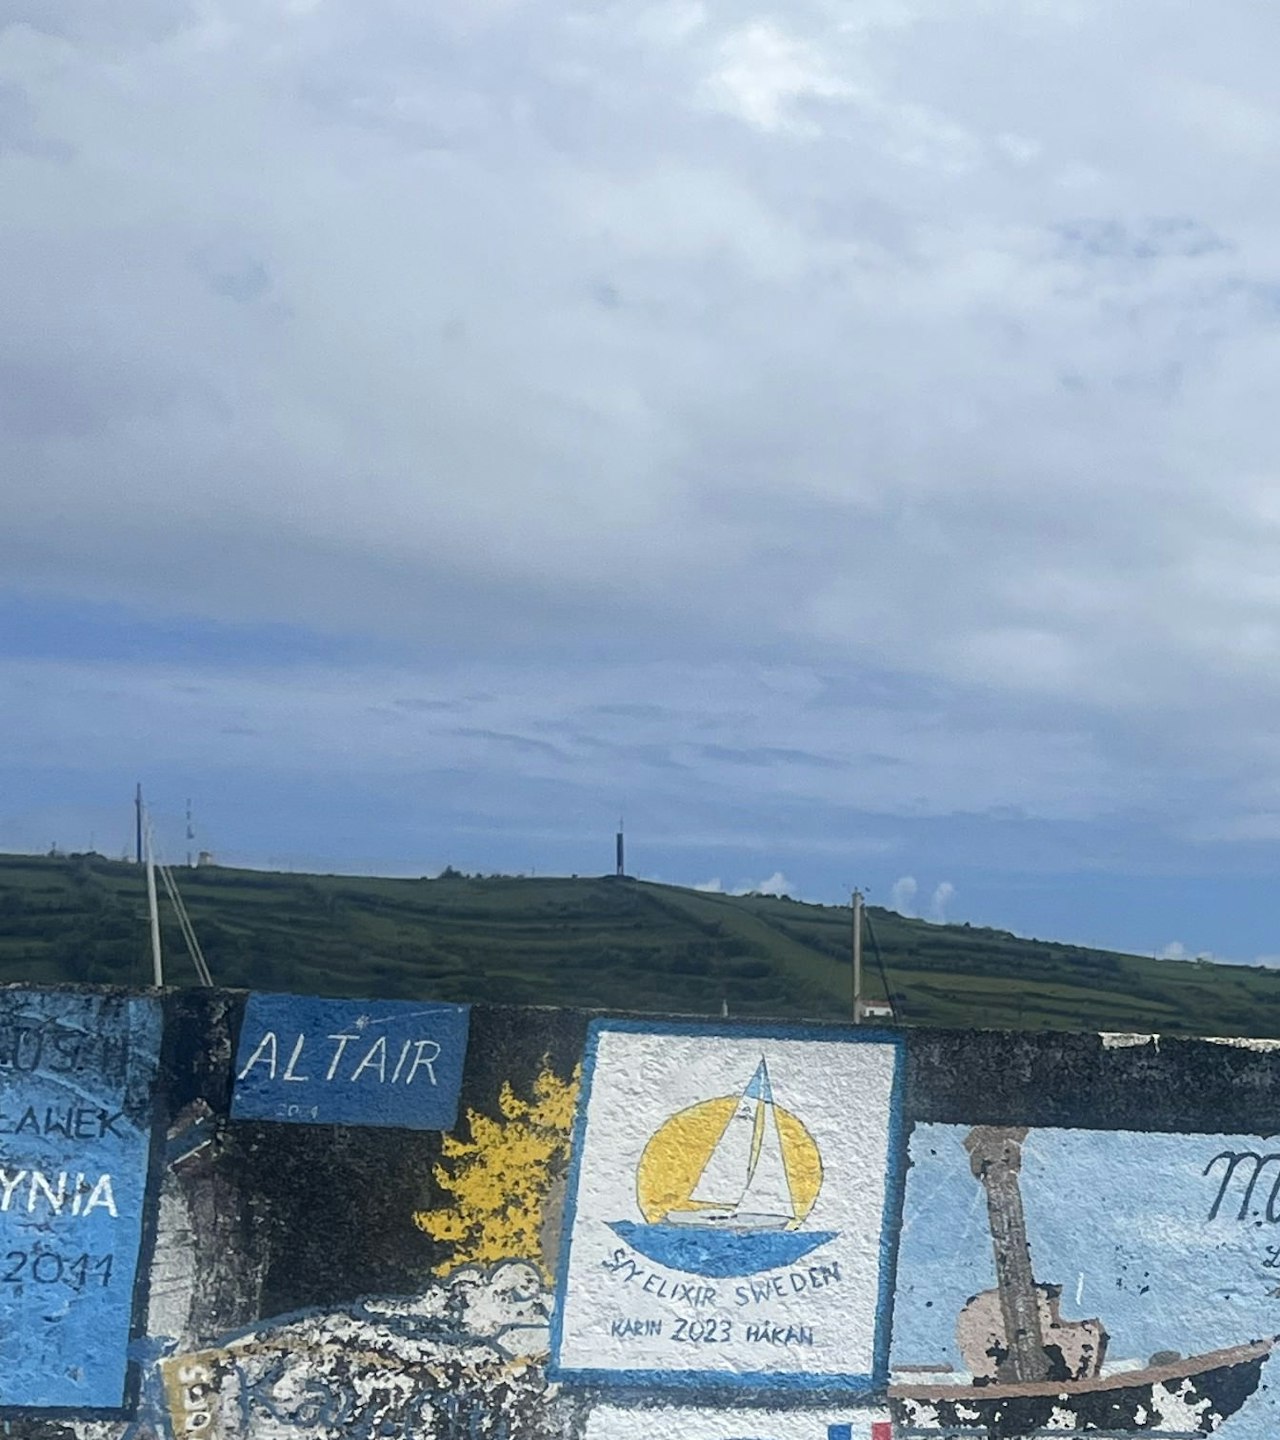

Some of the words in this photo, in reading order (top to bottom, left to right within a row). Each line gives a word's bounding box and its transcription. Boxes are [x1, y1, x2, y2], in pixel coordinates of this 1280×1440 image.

[237, 1031, 437, 1086] ALTAIR
[0, 1106, 124, 1138] AWEK
[2, 1251, 113, 1288] 2011
[643, 1274, 716, 1308] ELIXIR
[735, 1261, 841, 1306] SWEDEN
[611, 1318, 662, 1338] KARIN
[670, 1318, 731, 1343] 2023
[746, 1320, 814, 1347] HÅKAN
